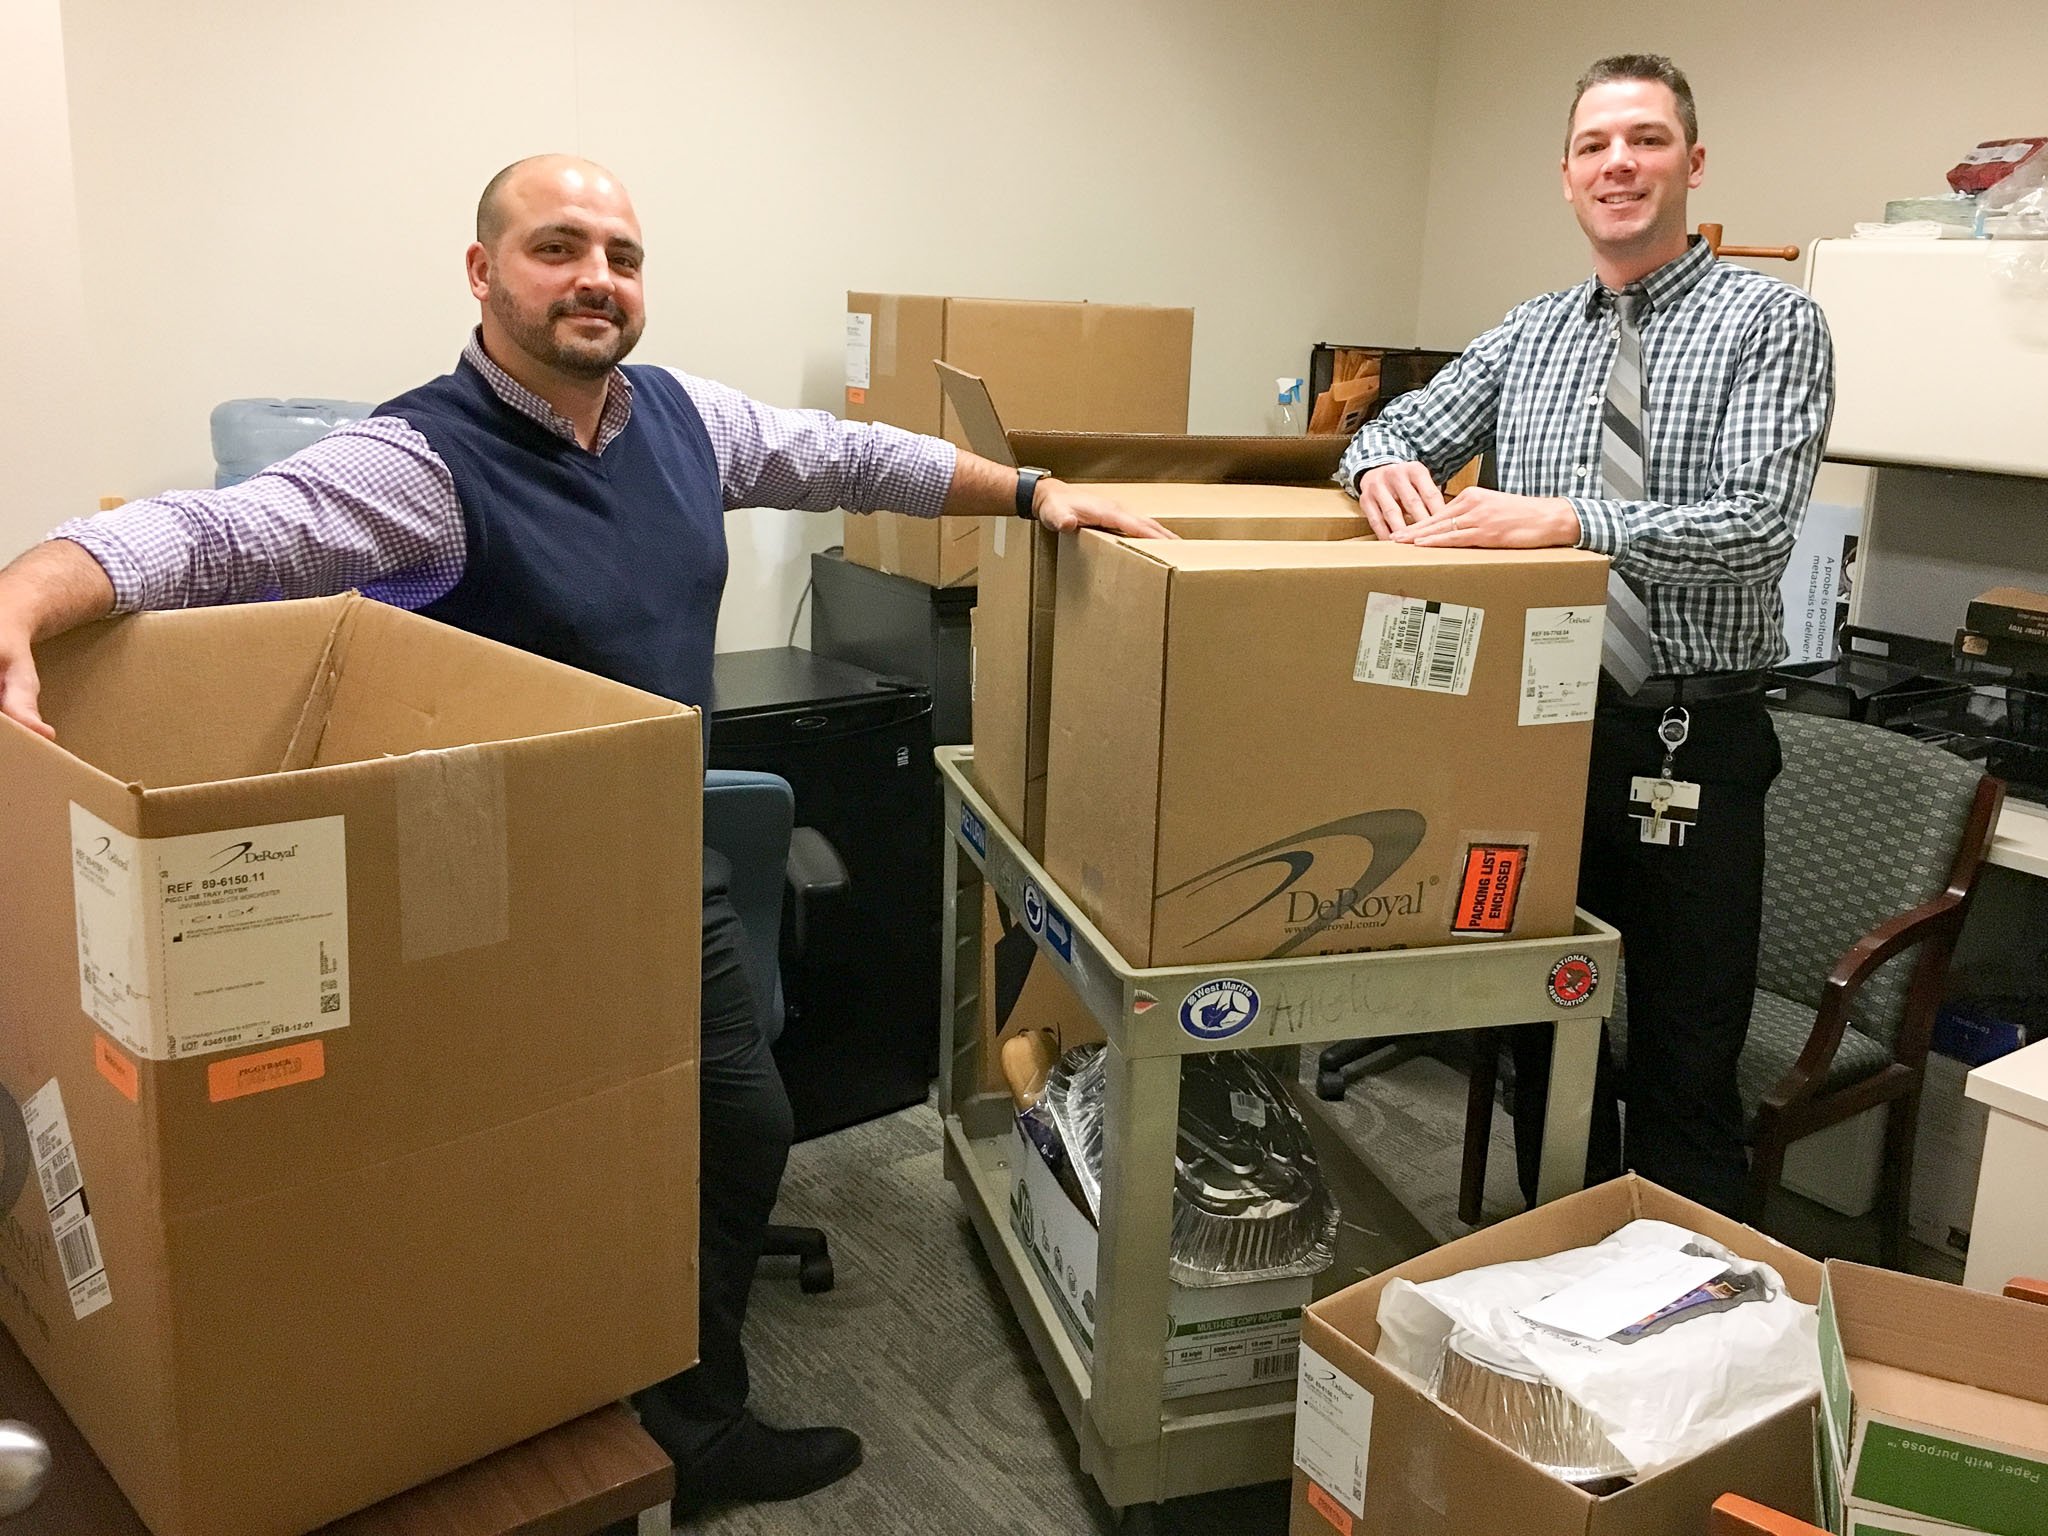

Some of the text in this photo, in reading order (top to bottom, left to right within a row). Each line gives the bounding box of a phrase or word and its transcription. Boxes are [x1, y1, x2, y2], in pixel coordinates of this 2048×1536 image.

[1808, 555, 1820, 606] metastasis
[1806, 609, 1815, 619] to
[1816, 556, 1835, 659] A probe is positioned
[1395, 639, 1404, 649] MA
[1803, 621, 1814, 653] deliver
[245, 845, 297, 864] DeRoyal
[167, 872, 266, 895] REF 89-6150.11
[1468, 849, 1497, 927] PACKING LIST
[1489, 860, 1512, 919] ENCLOSED
[203, 890, 222, 899] TRAY
[1287, 881, 1424, 927] DeRoyal
[1551, 955, 1598, 984] NATIONAL RIFLE
[1194, 981, 1253, 999] West Marine
[1548, 985, 1589, 1006] ASSOCIATION
[181, 1041, 198, 1052] LOT
[1197, 1316, 1235, 1332] MULTI-USE
[1236, 1314, 1258, 1327] COPY
[1258, 1311, 1283, 1323] PAPER
[1964, 1455, 1993, 1470] with
[1999, 1463, 2040, 1484] Paper
